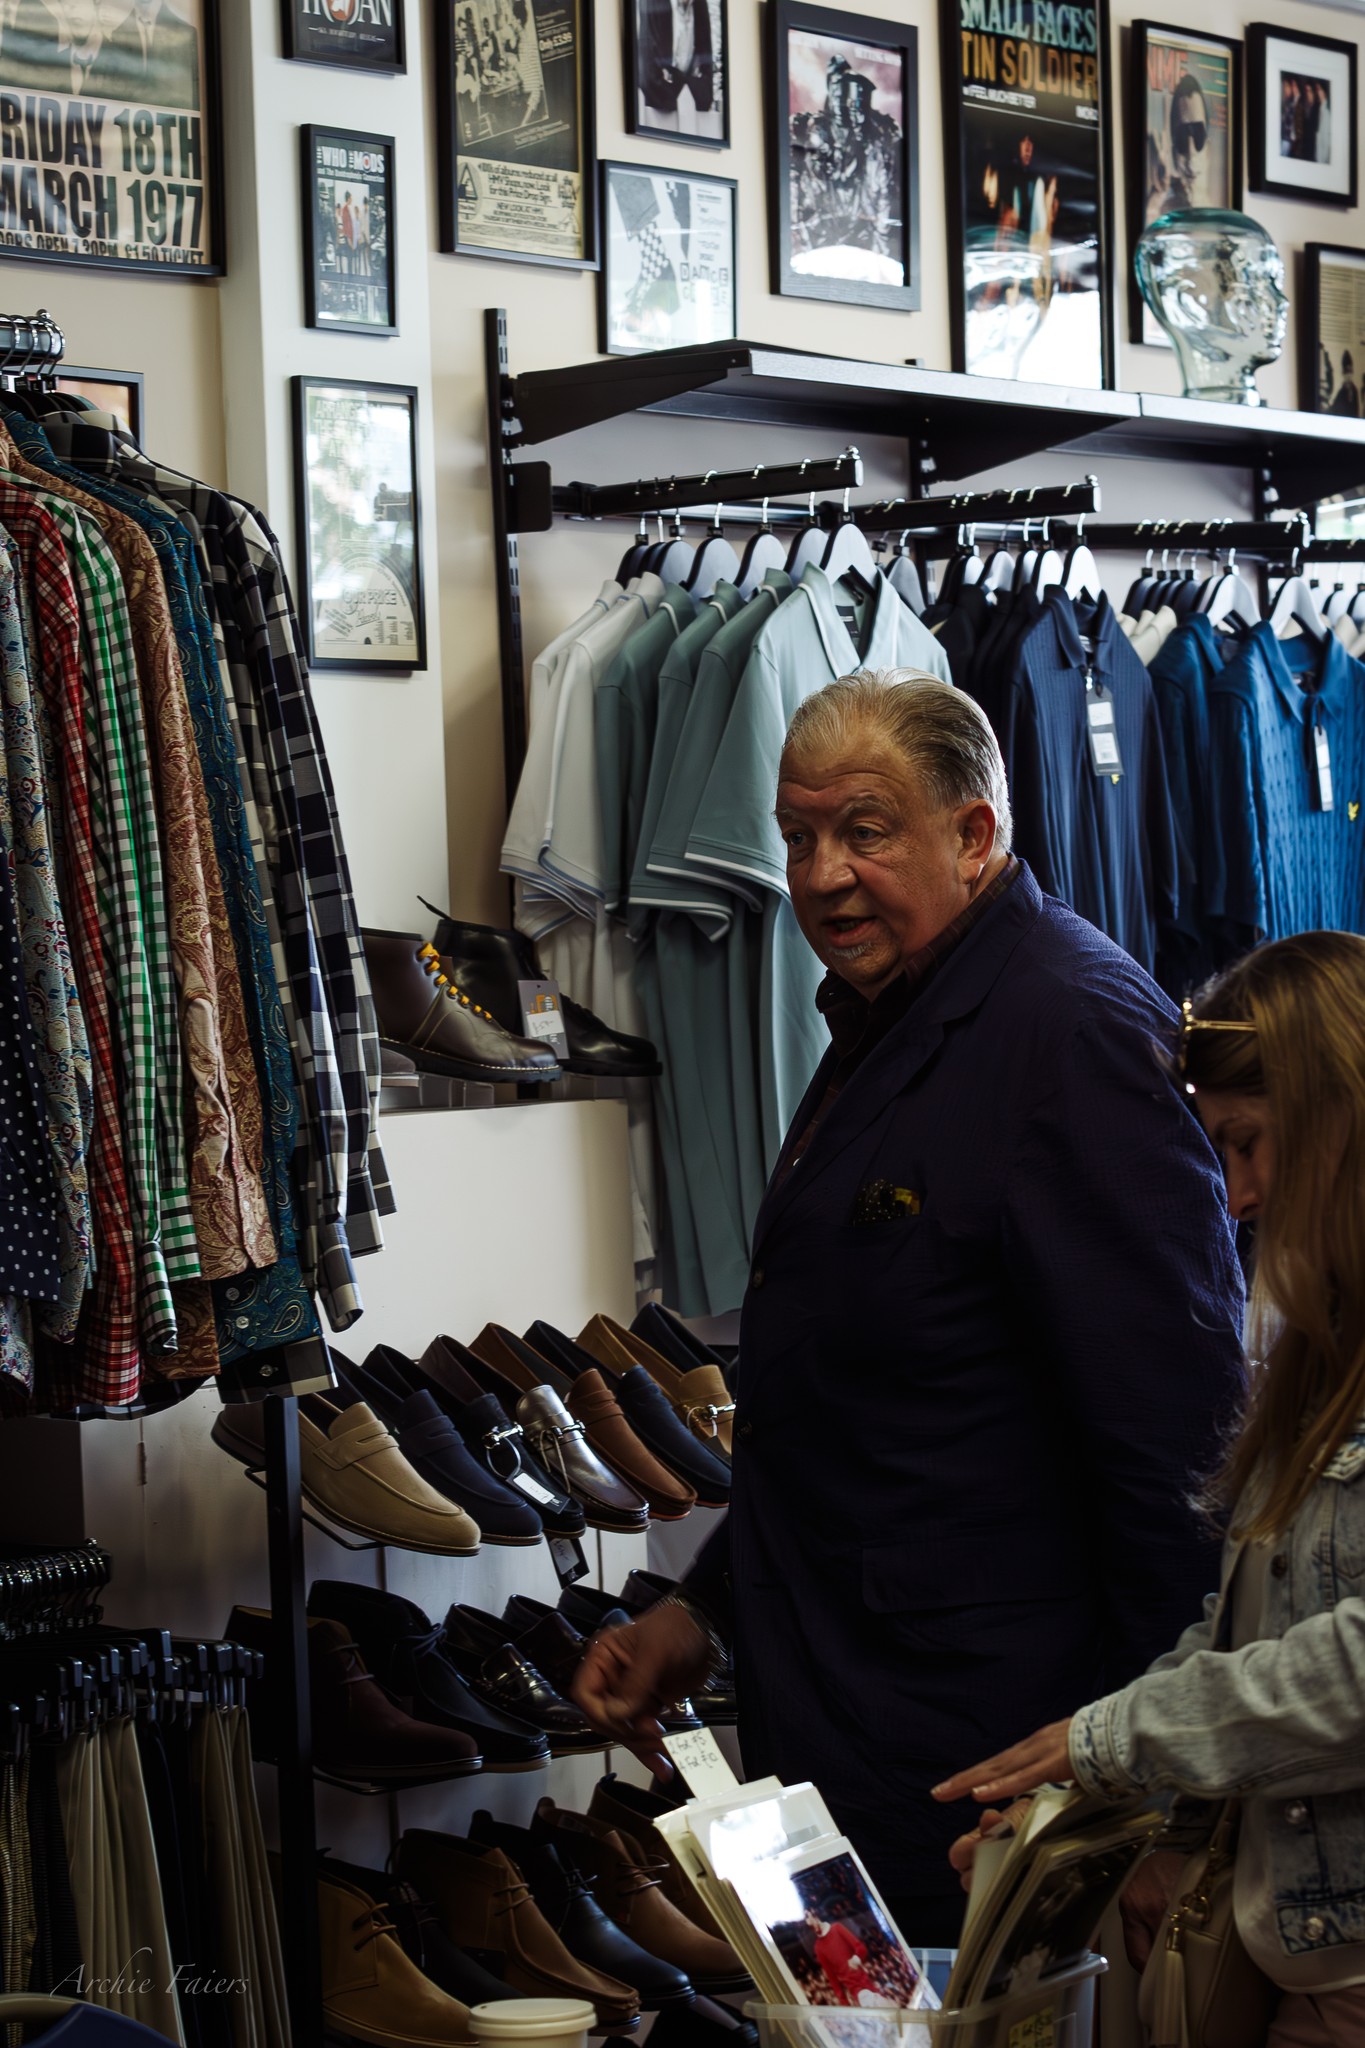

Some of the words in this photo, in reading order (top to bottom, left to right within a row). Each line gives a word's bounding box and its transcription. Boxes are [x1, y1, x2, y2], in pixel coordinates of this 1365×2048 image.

[961, 0, 1030, 40] SMALL
[1032, 0, 1097, 53] FACES
[961, 31, 996, 82] TIN
[1002, 39, 1098, 103] SOLDIER
[0, 93, 106, 168] RIDAY
[114, 108, 202, 180] 18TH
[322, 146, 347, 168] WHO
[353, 151, 385, 174] MODS
[127, 179, 203, 248] 1977
